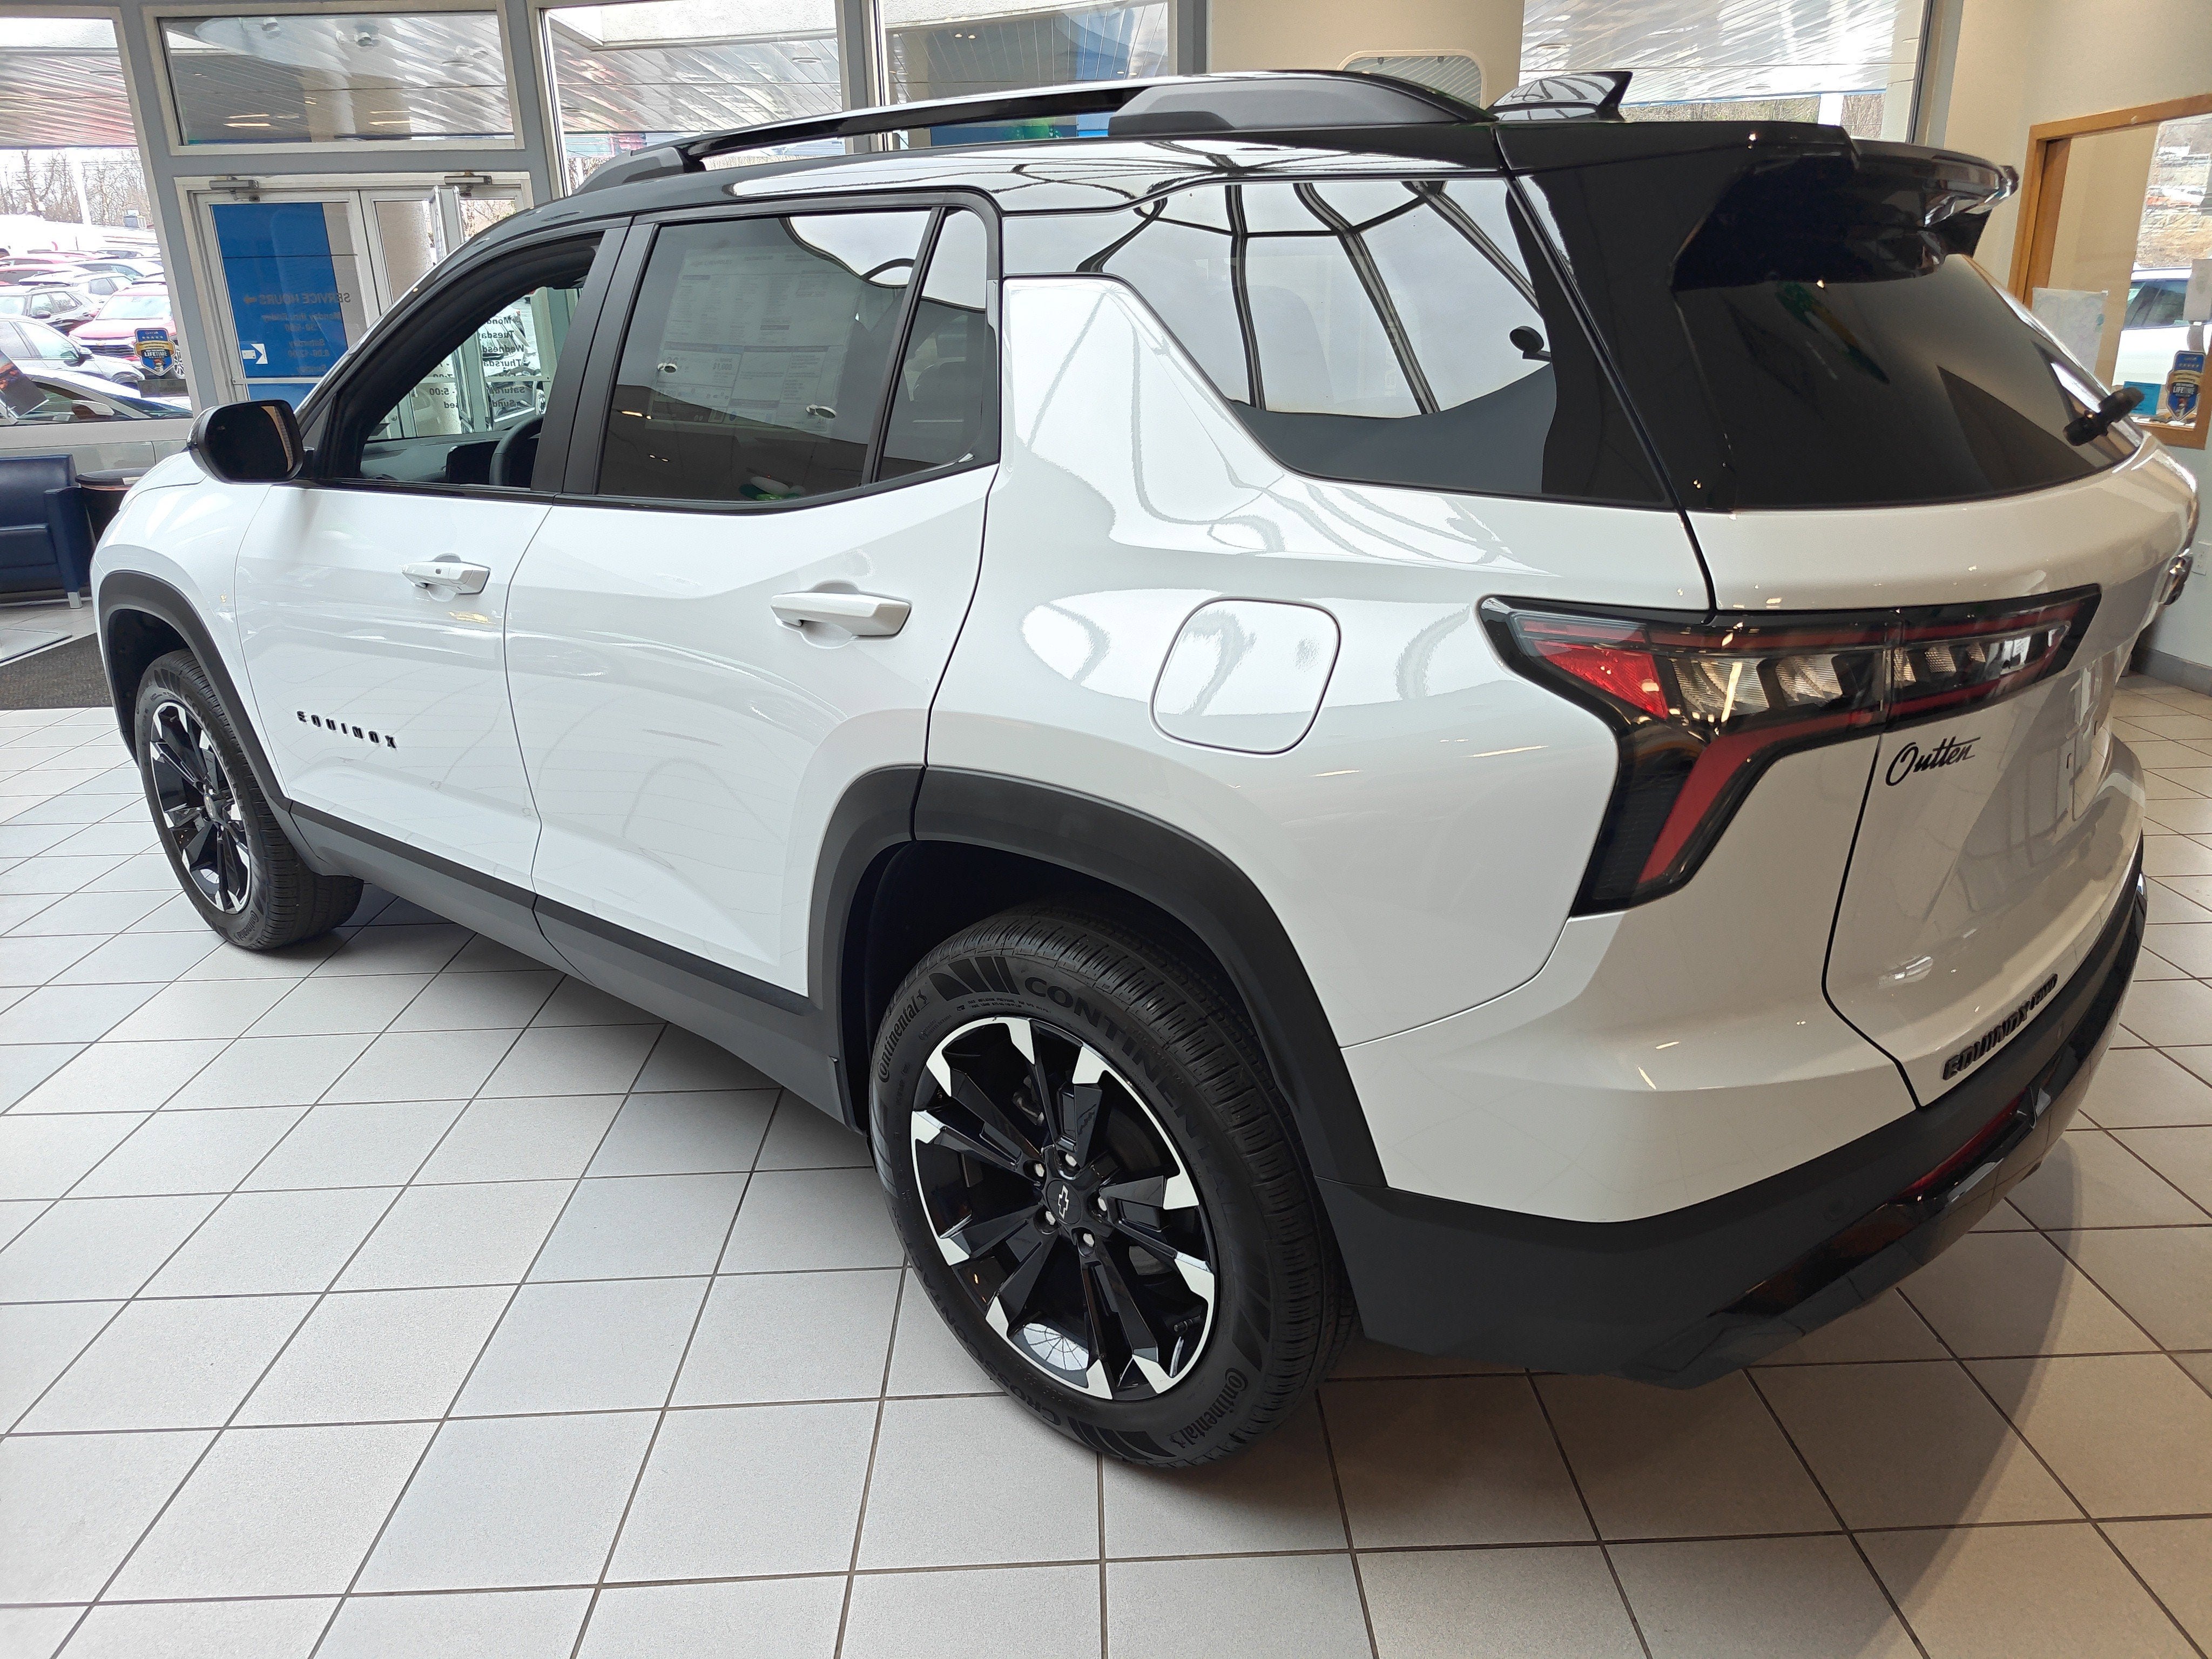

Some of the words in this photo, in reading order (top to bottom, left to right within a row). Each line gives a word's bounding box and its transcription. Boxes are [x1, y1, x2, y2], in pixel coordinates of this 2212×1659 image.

[296, 710, 398, 750] EQUINOX
[1885, 736, 1981, 787] Outten
[878, 997, 920, 1083] Continental
[1179, 1367, 1249, 1446] Continental
